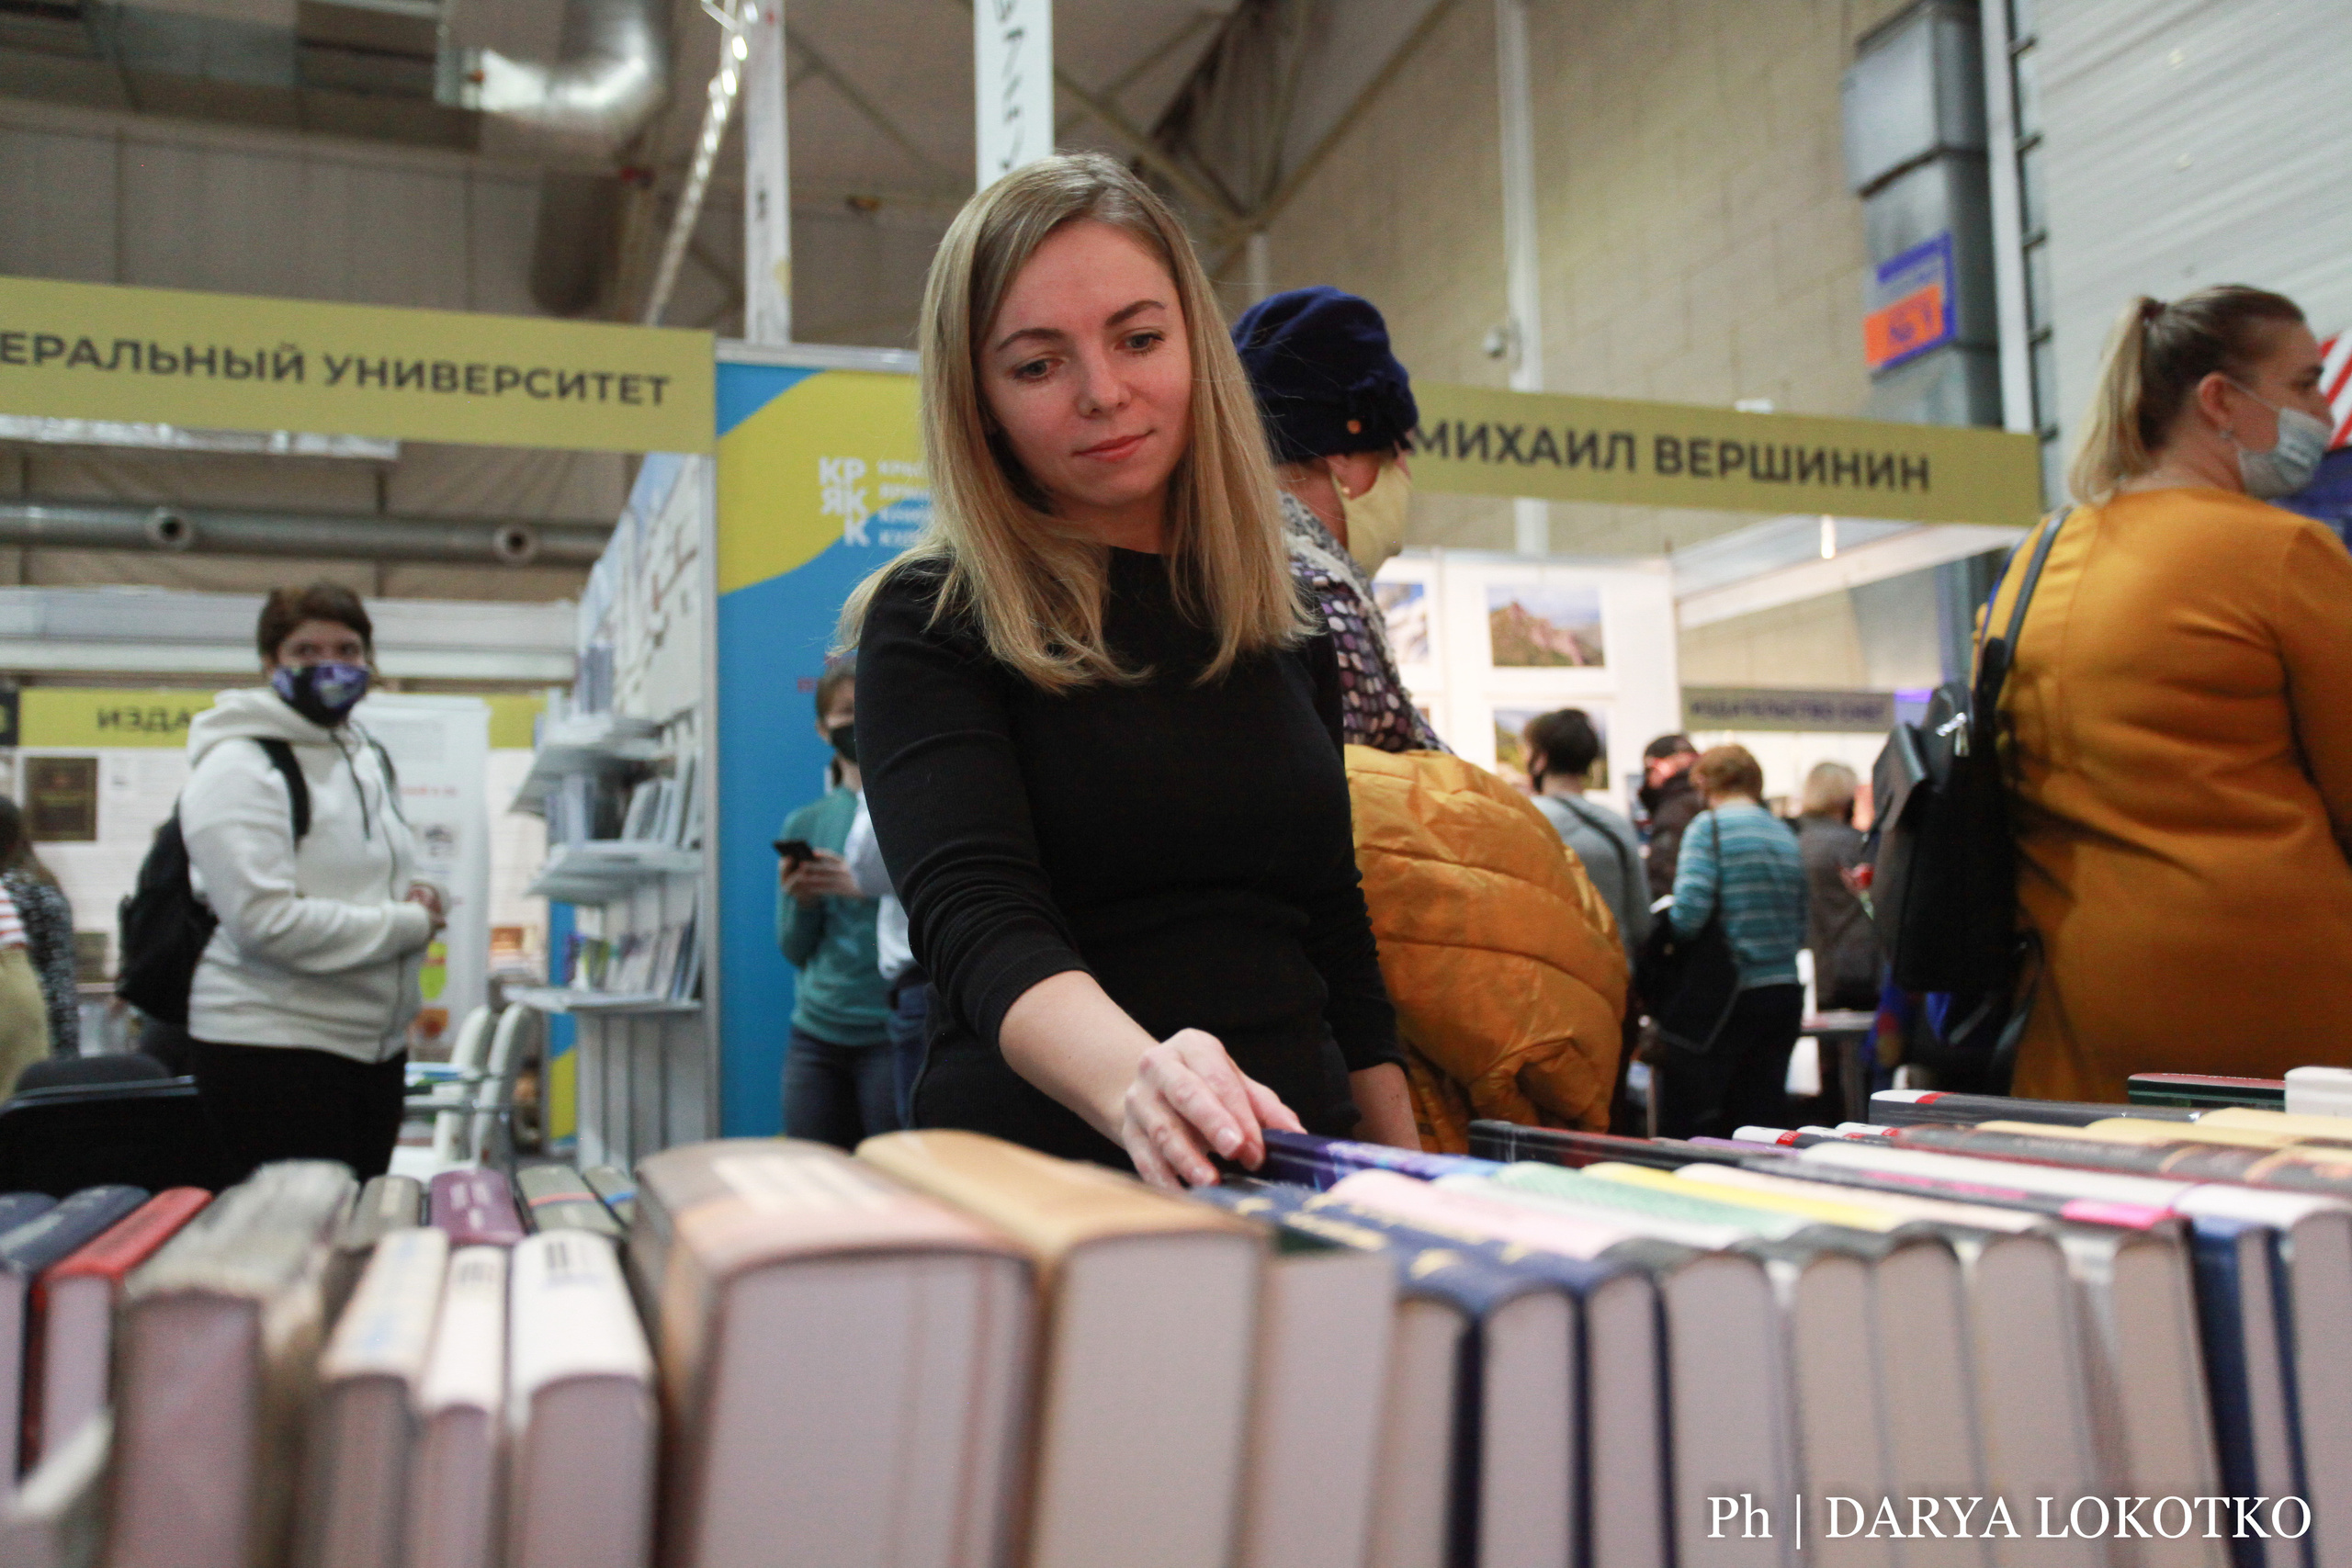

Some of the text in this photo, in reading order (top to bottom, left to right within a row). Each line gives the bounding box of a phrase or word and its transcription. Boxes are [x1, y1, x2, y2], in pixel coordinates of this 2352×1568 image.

[0, 331, 670, 406] ЕРАЛЬНЫЙ УНИВЕРСИТЕТ
[819, 457, 866, 486] КР
[1412, 419, 1930, 493] МИХАИЛ ВЕРШИНИН
